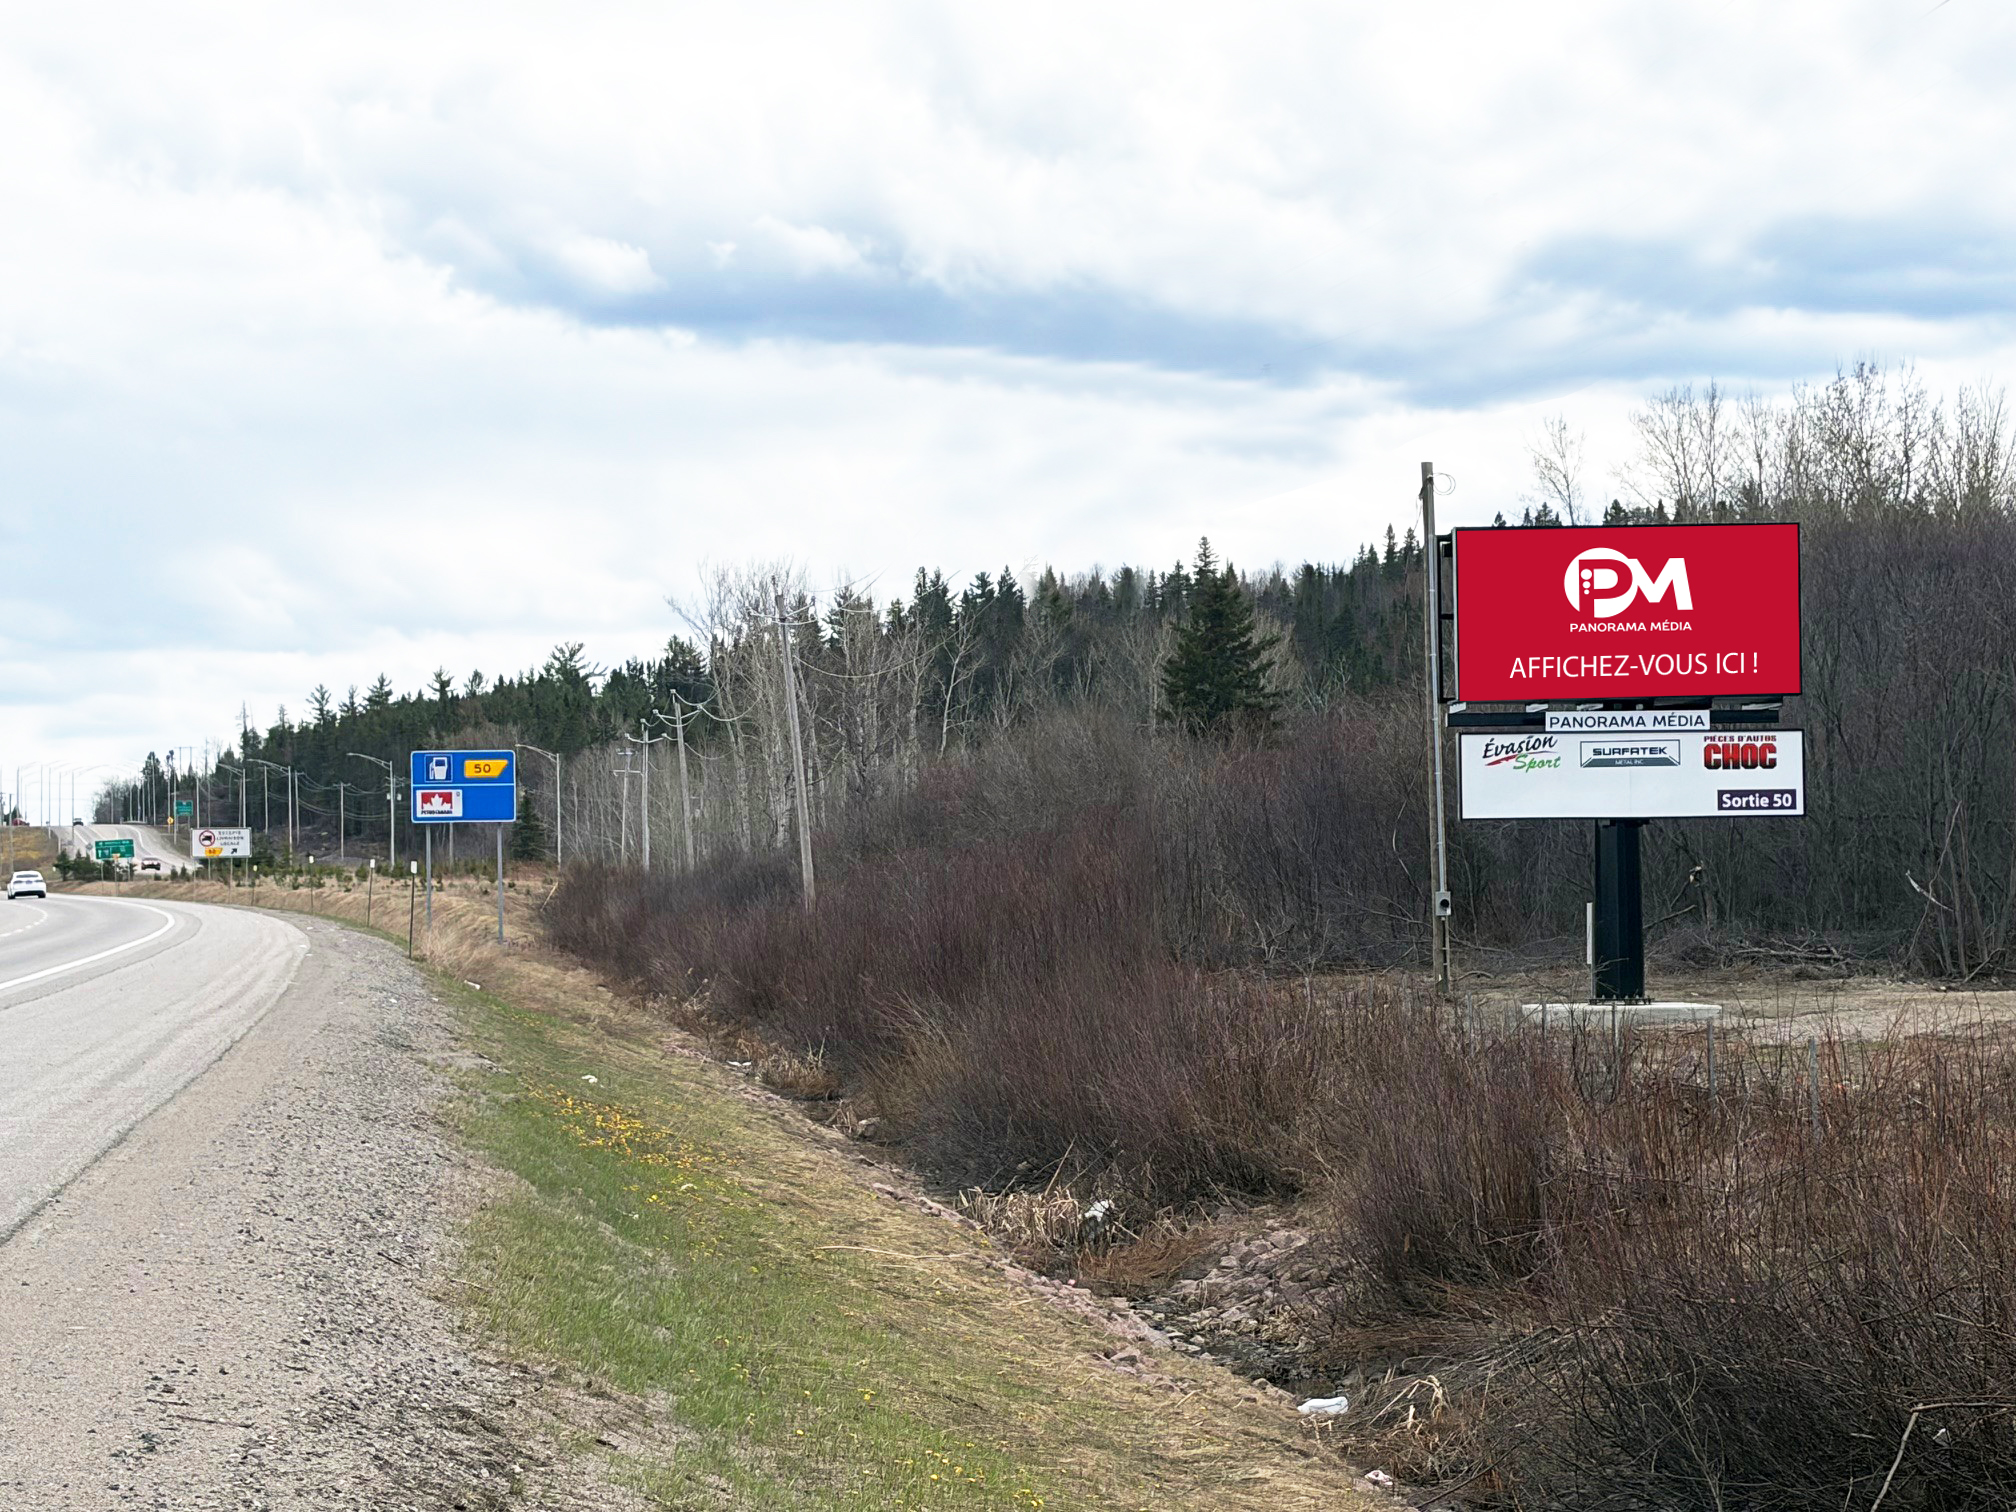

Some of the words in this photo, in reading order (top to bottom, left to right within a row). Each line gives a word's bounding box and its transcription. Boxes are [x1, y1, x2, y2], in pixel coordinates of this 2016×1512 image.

[1569, 621, 1647, 633] PANORAMA
[1650, 619, 1693, 632] MÉDIA
[1509, 653, 1708, 679] AFFICHEZ-VOUS
[1716, 652, 1745, 674] ICI
[1753, 652, 1759, 674] !
[1549, 715, 1647, 729] PANORAMA
[1652, 712, 1706, 728] MÉDIA
[1737, 734, 1777, 742] D'AUTOS
[1482, 735, 1558, 759] Évasion
[1592, 746, 1669, 756] SURFATEK
[1513, 753, 1561, 773] Sport
[1704, 743, 1777, 770] CHOC
[474, 763, 491, 774] 50
[1722, 793, 1769, 808] Sortie
[1772, 793, 1792, 807] 50
